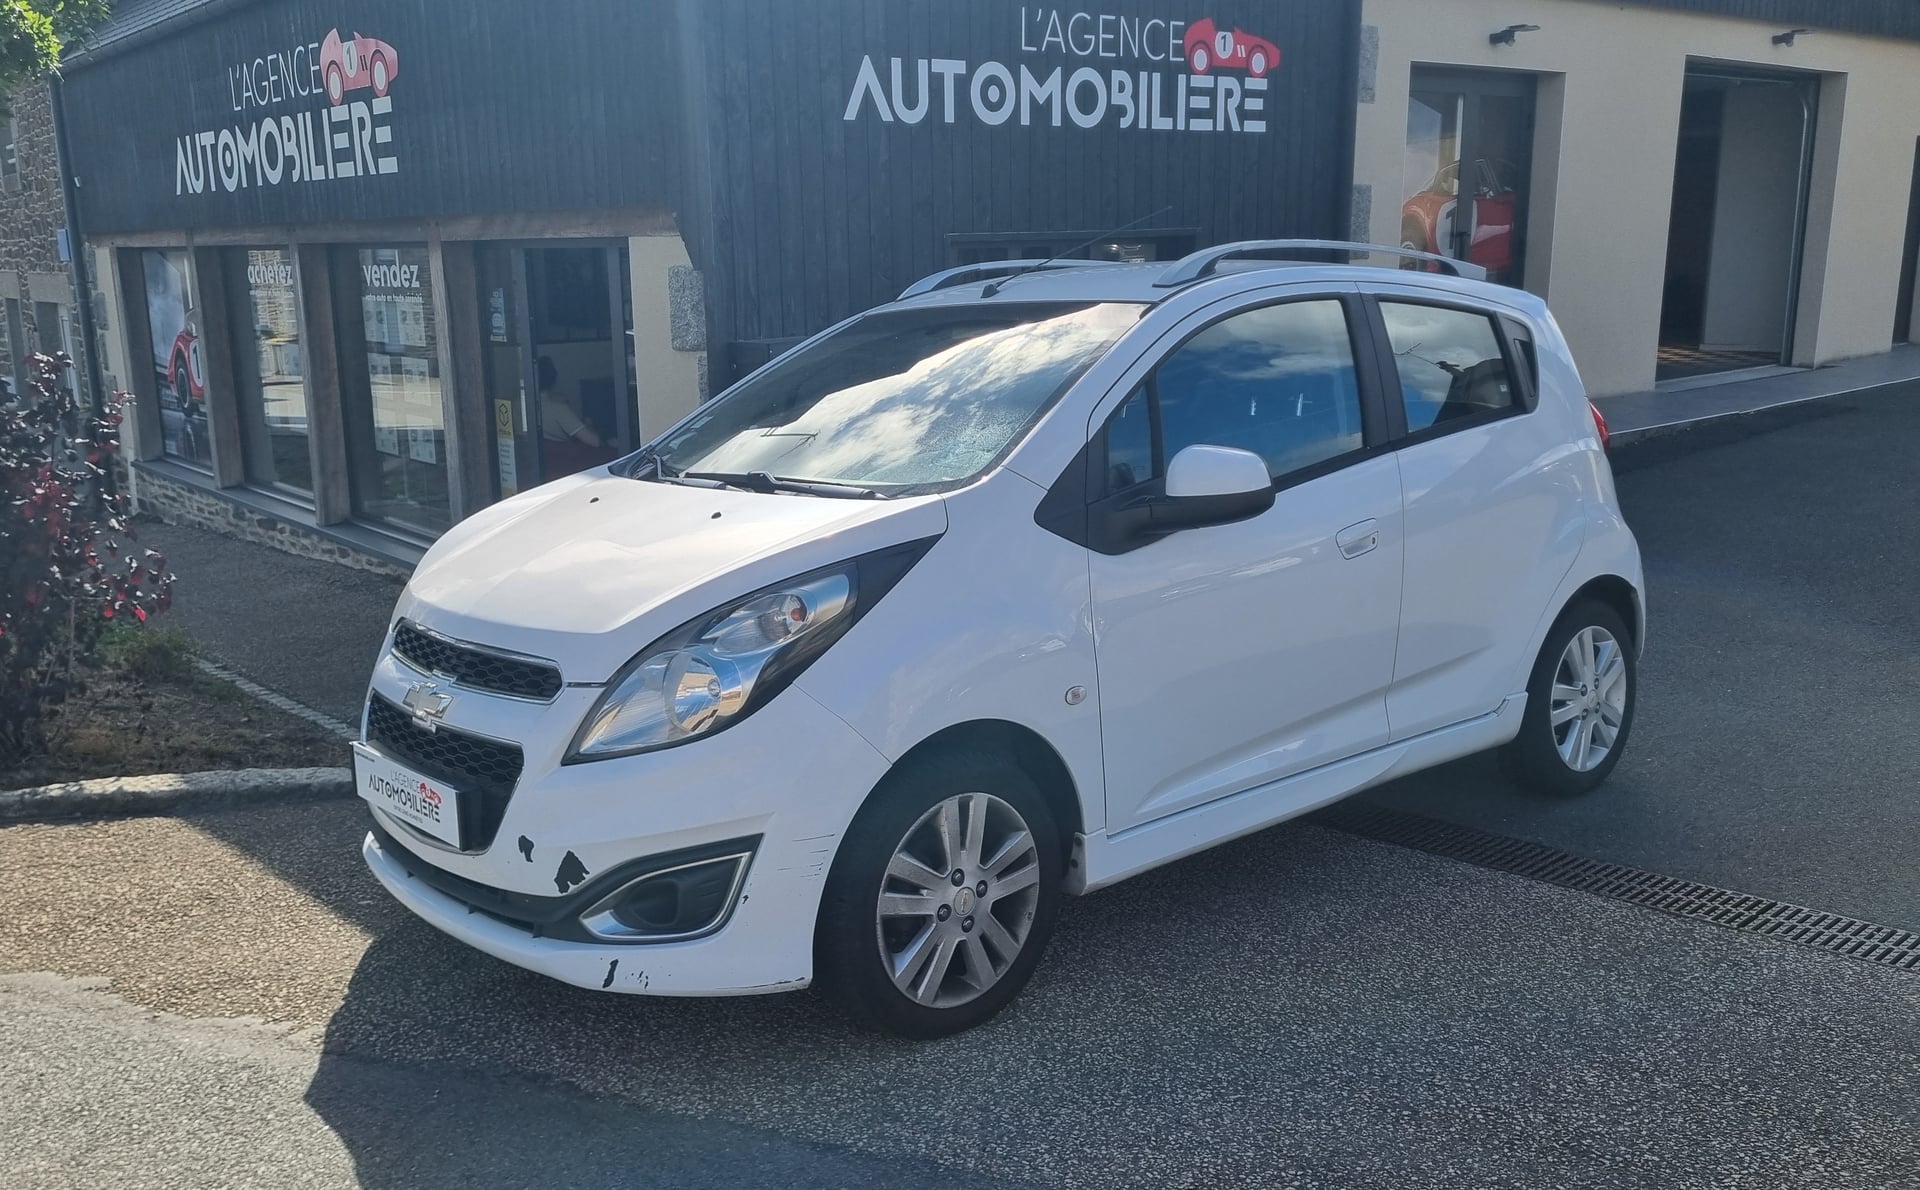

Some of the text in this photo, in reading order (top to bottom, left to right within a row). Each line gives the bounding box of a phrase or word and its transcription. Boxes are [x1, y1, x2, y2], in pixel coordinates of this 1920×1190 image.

[346, 46, 353, 70] 1
[1020, 5, 1185, 62] L'AGENCE
[1220, 34, 1227, 52] 1
[228, 42, 324, 112] L'AGENCE
[843, 54, 1269, 133] AUTOMOBILIERE
[175, 95, 399, 196] AUTOMOBILIERE
[362, 249, 420, 288] vendez
[192, 346, 201, 380] 1
[368, 773, 441, 824] AUTOMOBILIERE
